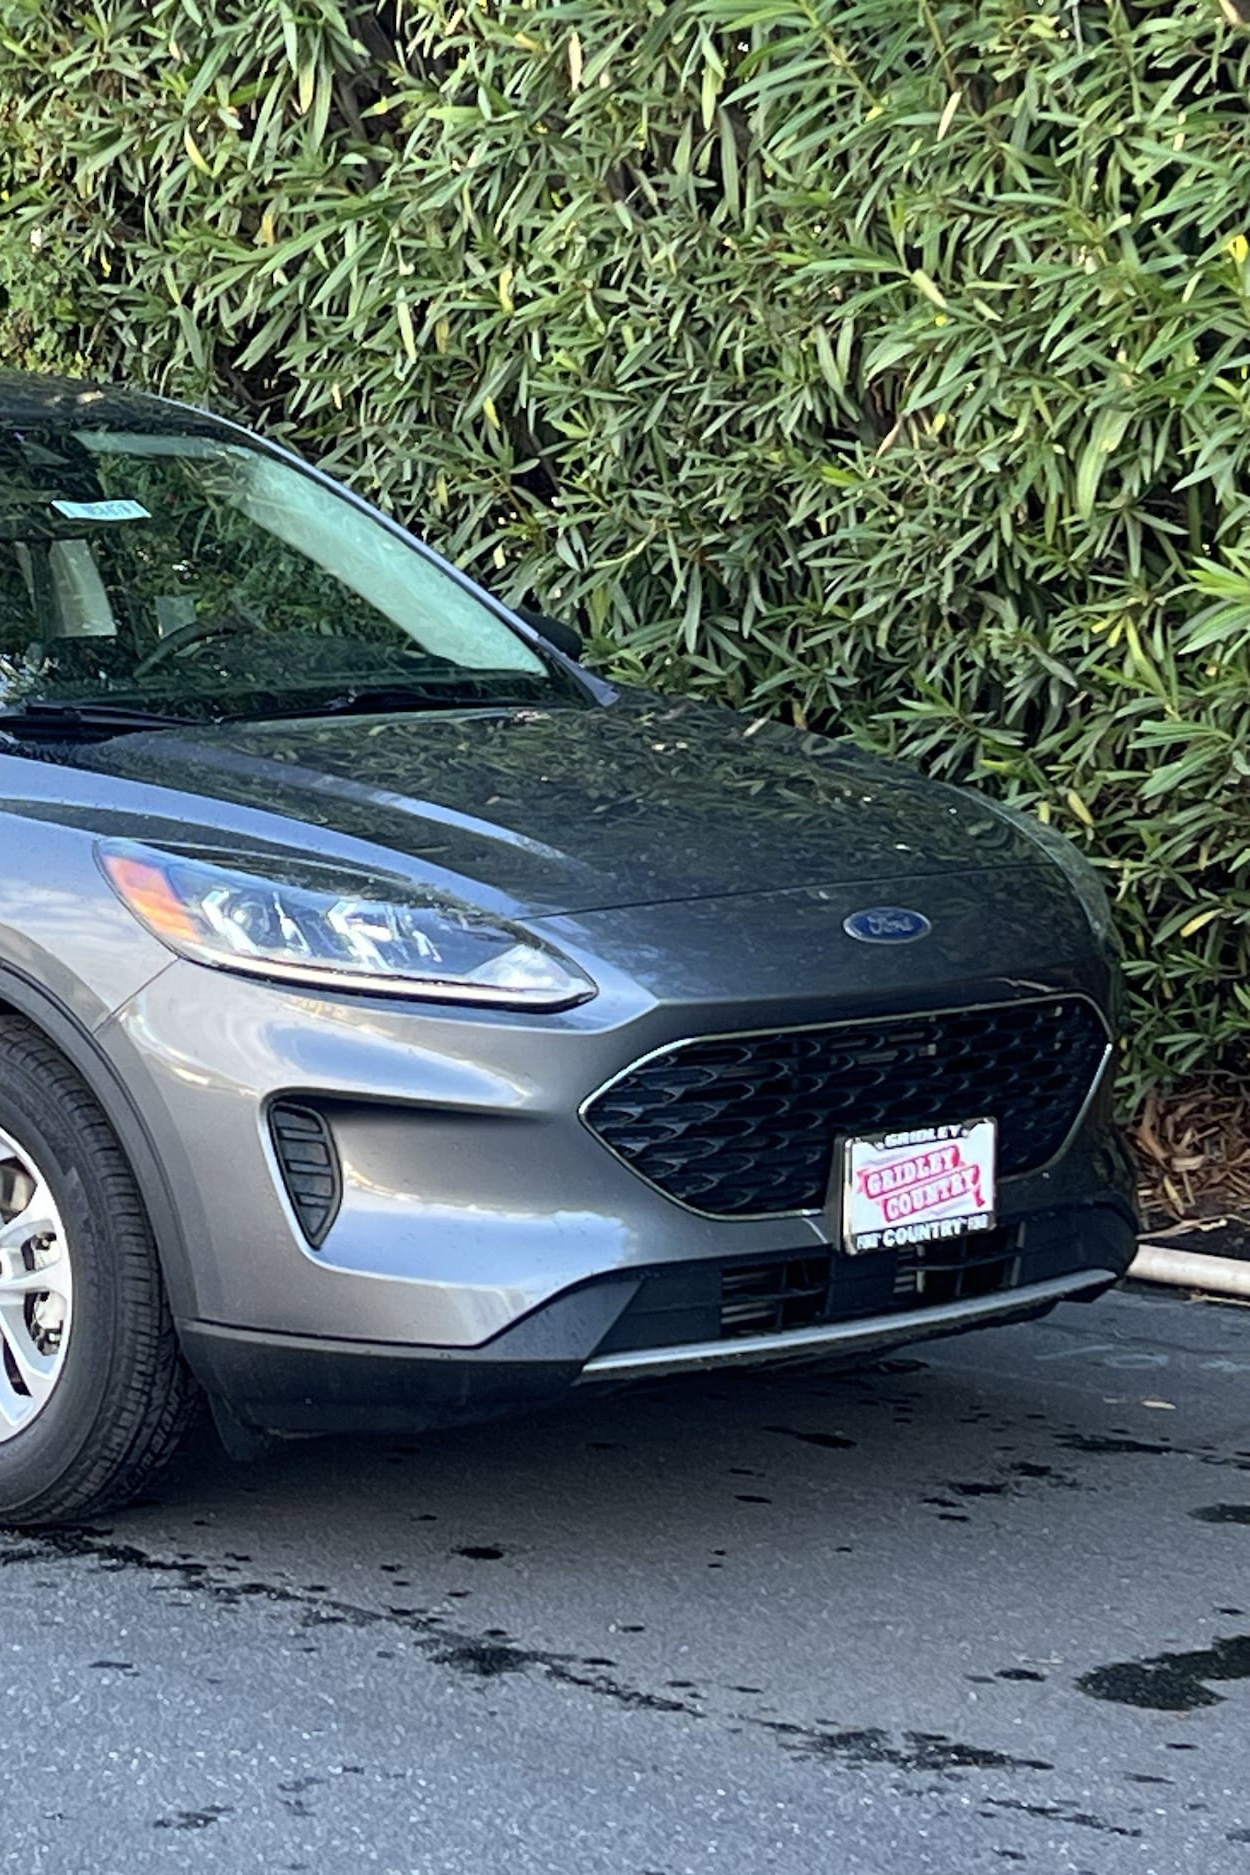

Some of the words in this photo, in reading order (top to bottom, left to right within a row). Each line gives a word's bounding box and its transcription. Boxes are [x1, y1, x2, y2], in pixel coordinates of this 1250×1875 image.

[884, 1124, 962, 1148] GRIDLEY
[867, 1151, 955, 1196] GRIDLEY
[886, 1168, 976, 1218] COUNTRY
[882, 1219, 961, 1248] COUNTRY
